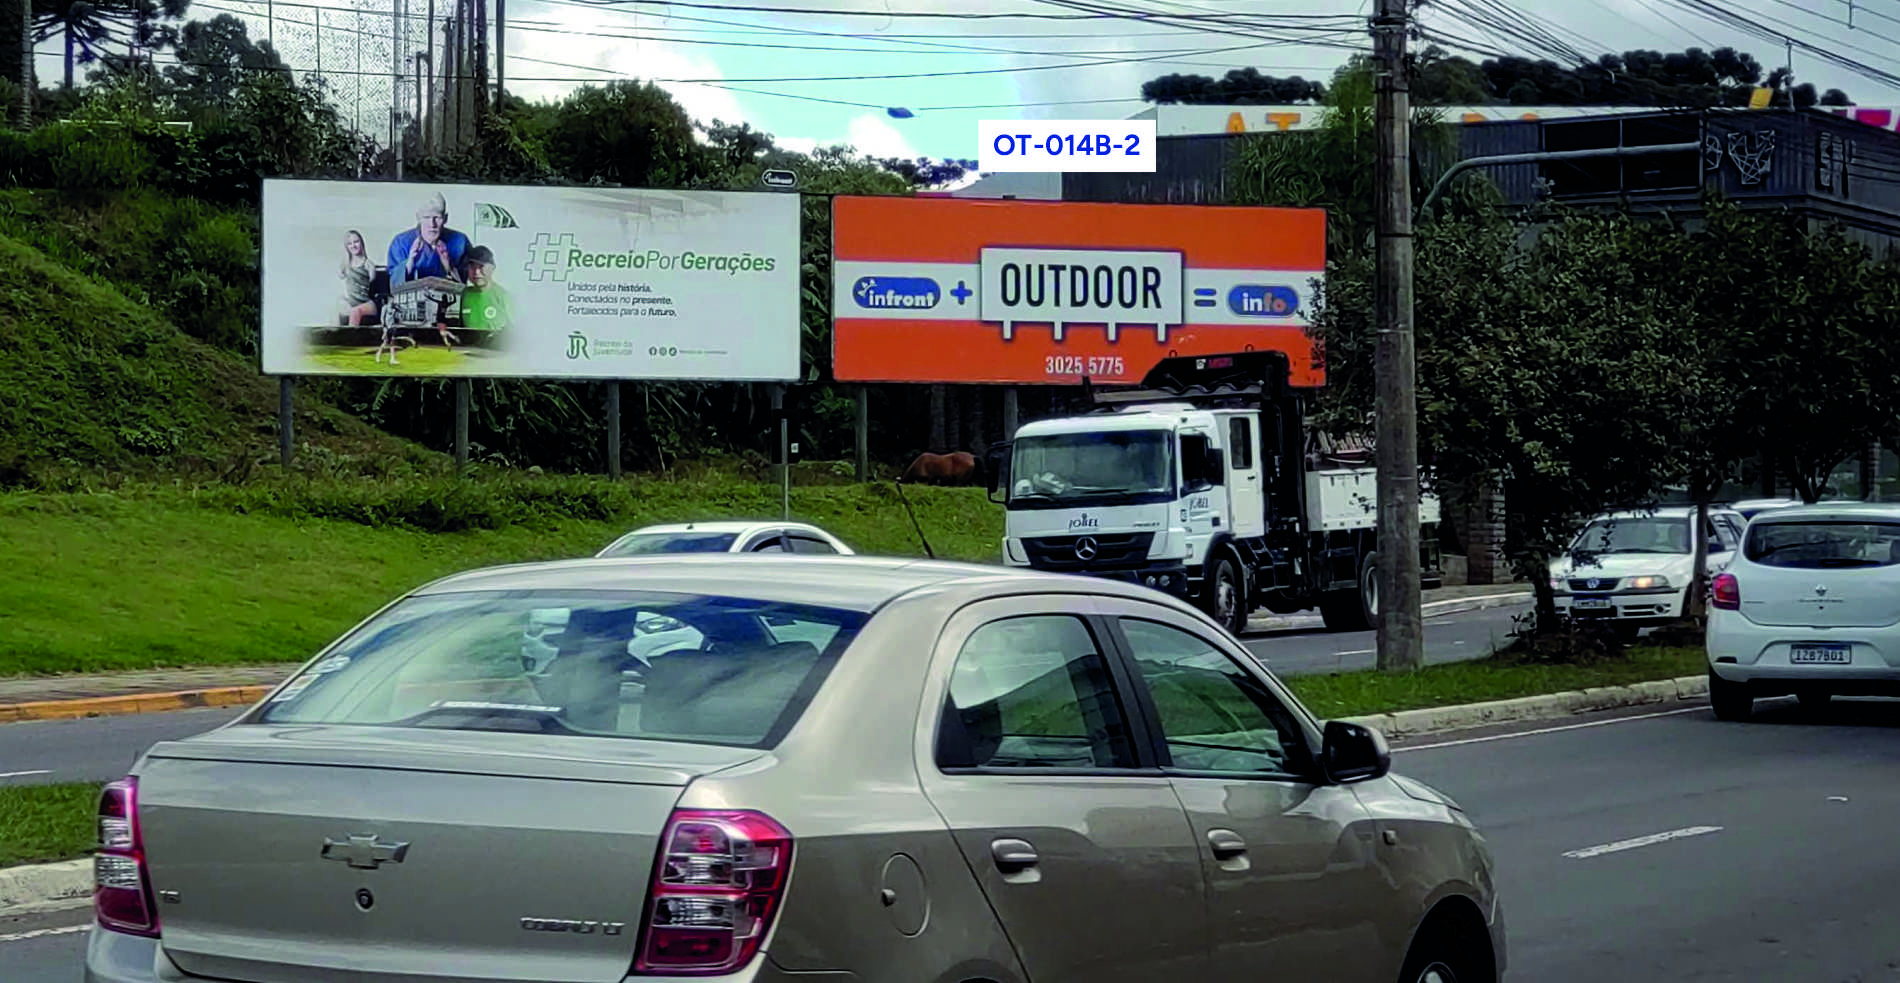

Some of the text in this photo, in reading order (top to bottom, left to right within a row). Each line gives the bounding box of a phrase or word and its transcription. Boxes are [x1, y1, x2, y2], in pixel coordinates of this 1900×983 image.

[868, 290, 934, 306] infront
[1000, 262, 1162, 309] OUTDOOR
[1242, 292, 1287, 312] info
[1045, 356, 1124, 375] 3025 5775
